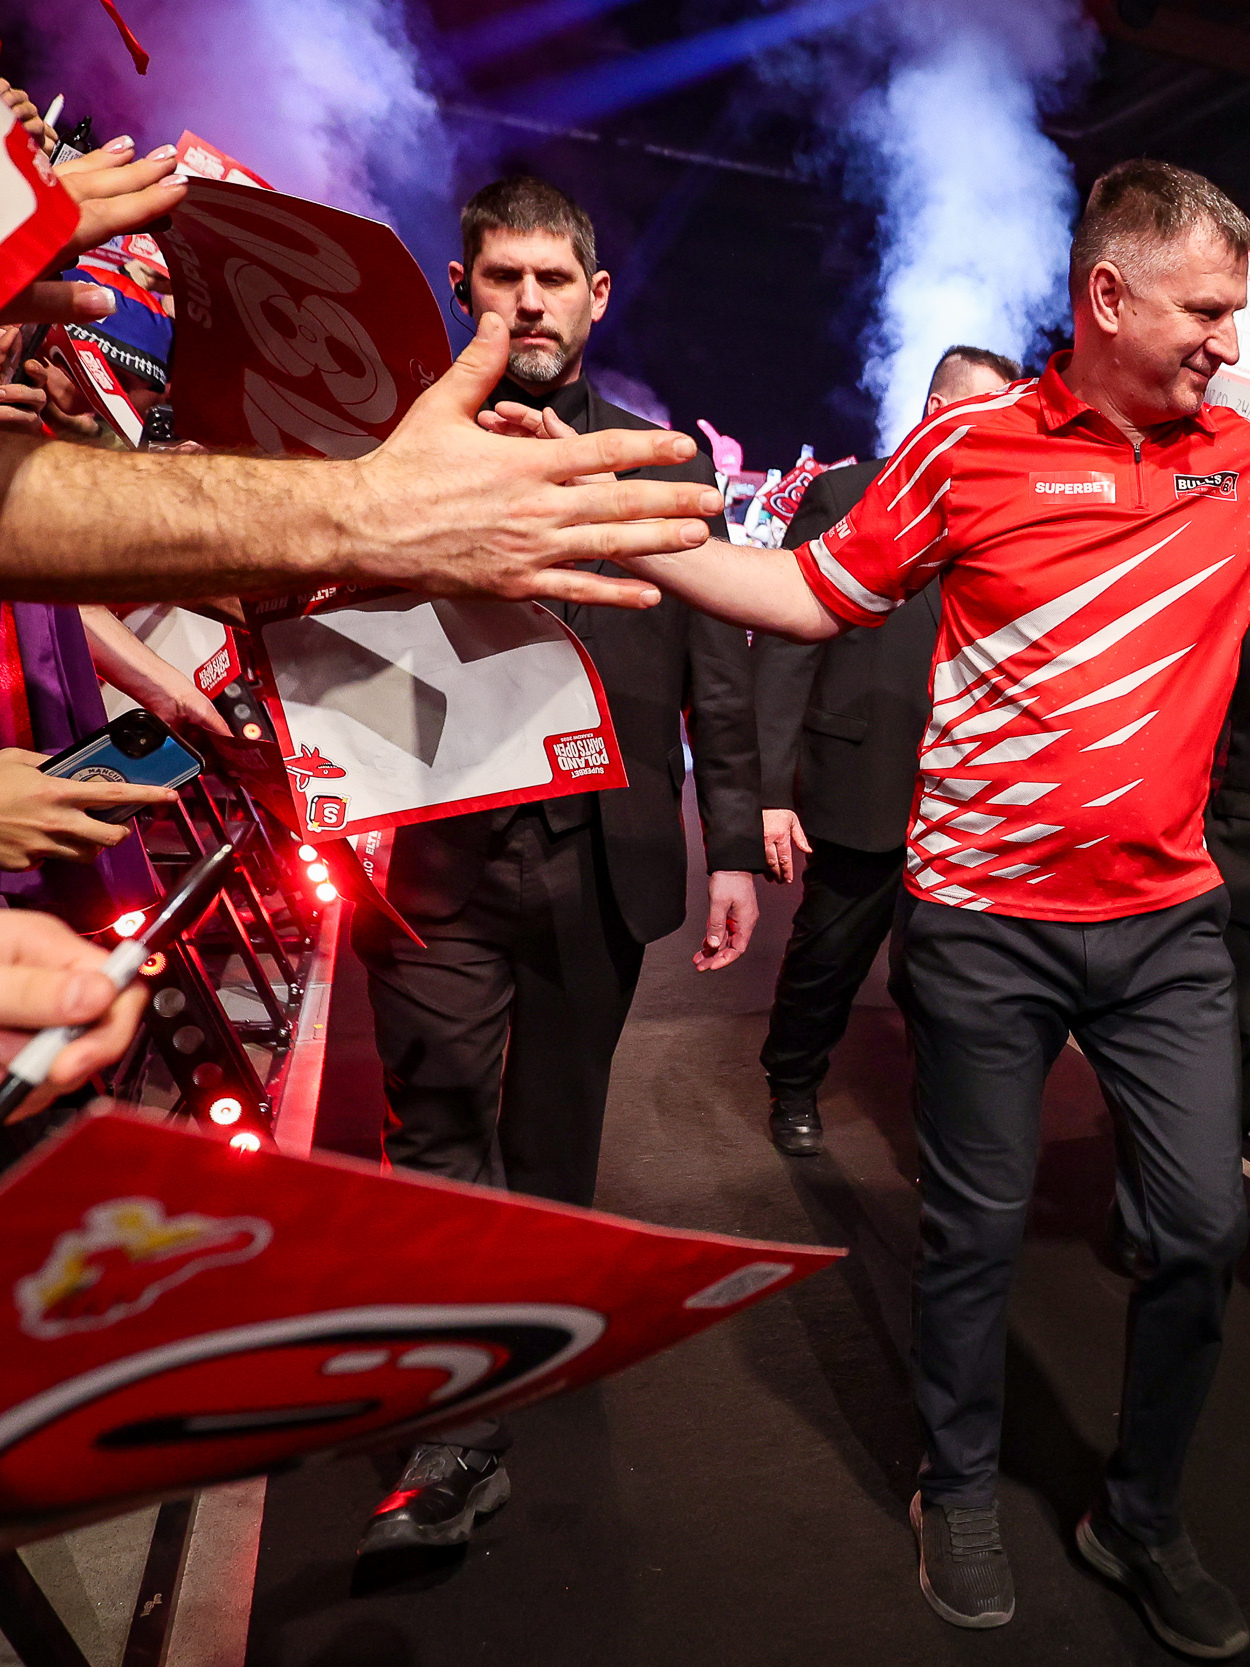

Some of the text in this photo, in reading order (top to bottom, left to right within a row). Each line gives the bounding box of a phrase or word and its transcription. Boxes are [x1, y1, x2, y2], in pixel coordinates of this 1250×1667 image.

[1035, 481, 1110, 495] SUPERBET
[553, 737, 605, 757] DARTS OPEN
[557, 748, 610, 771] POLAND
[88, 767, 124, 783] MANCHE
[571, 766, 605, 779] SUPERBET
[365, 830, 378, 855] ELTE
